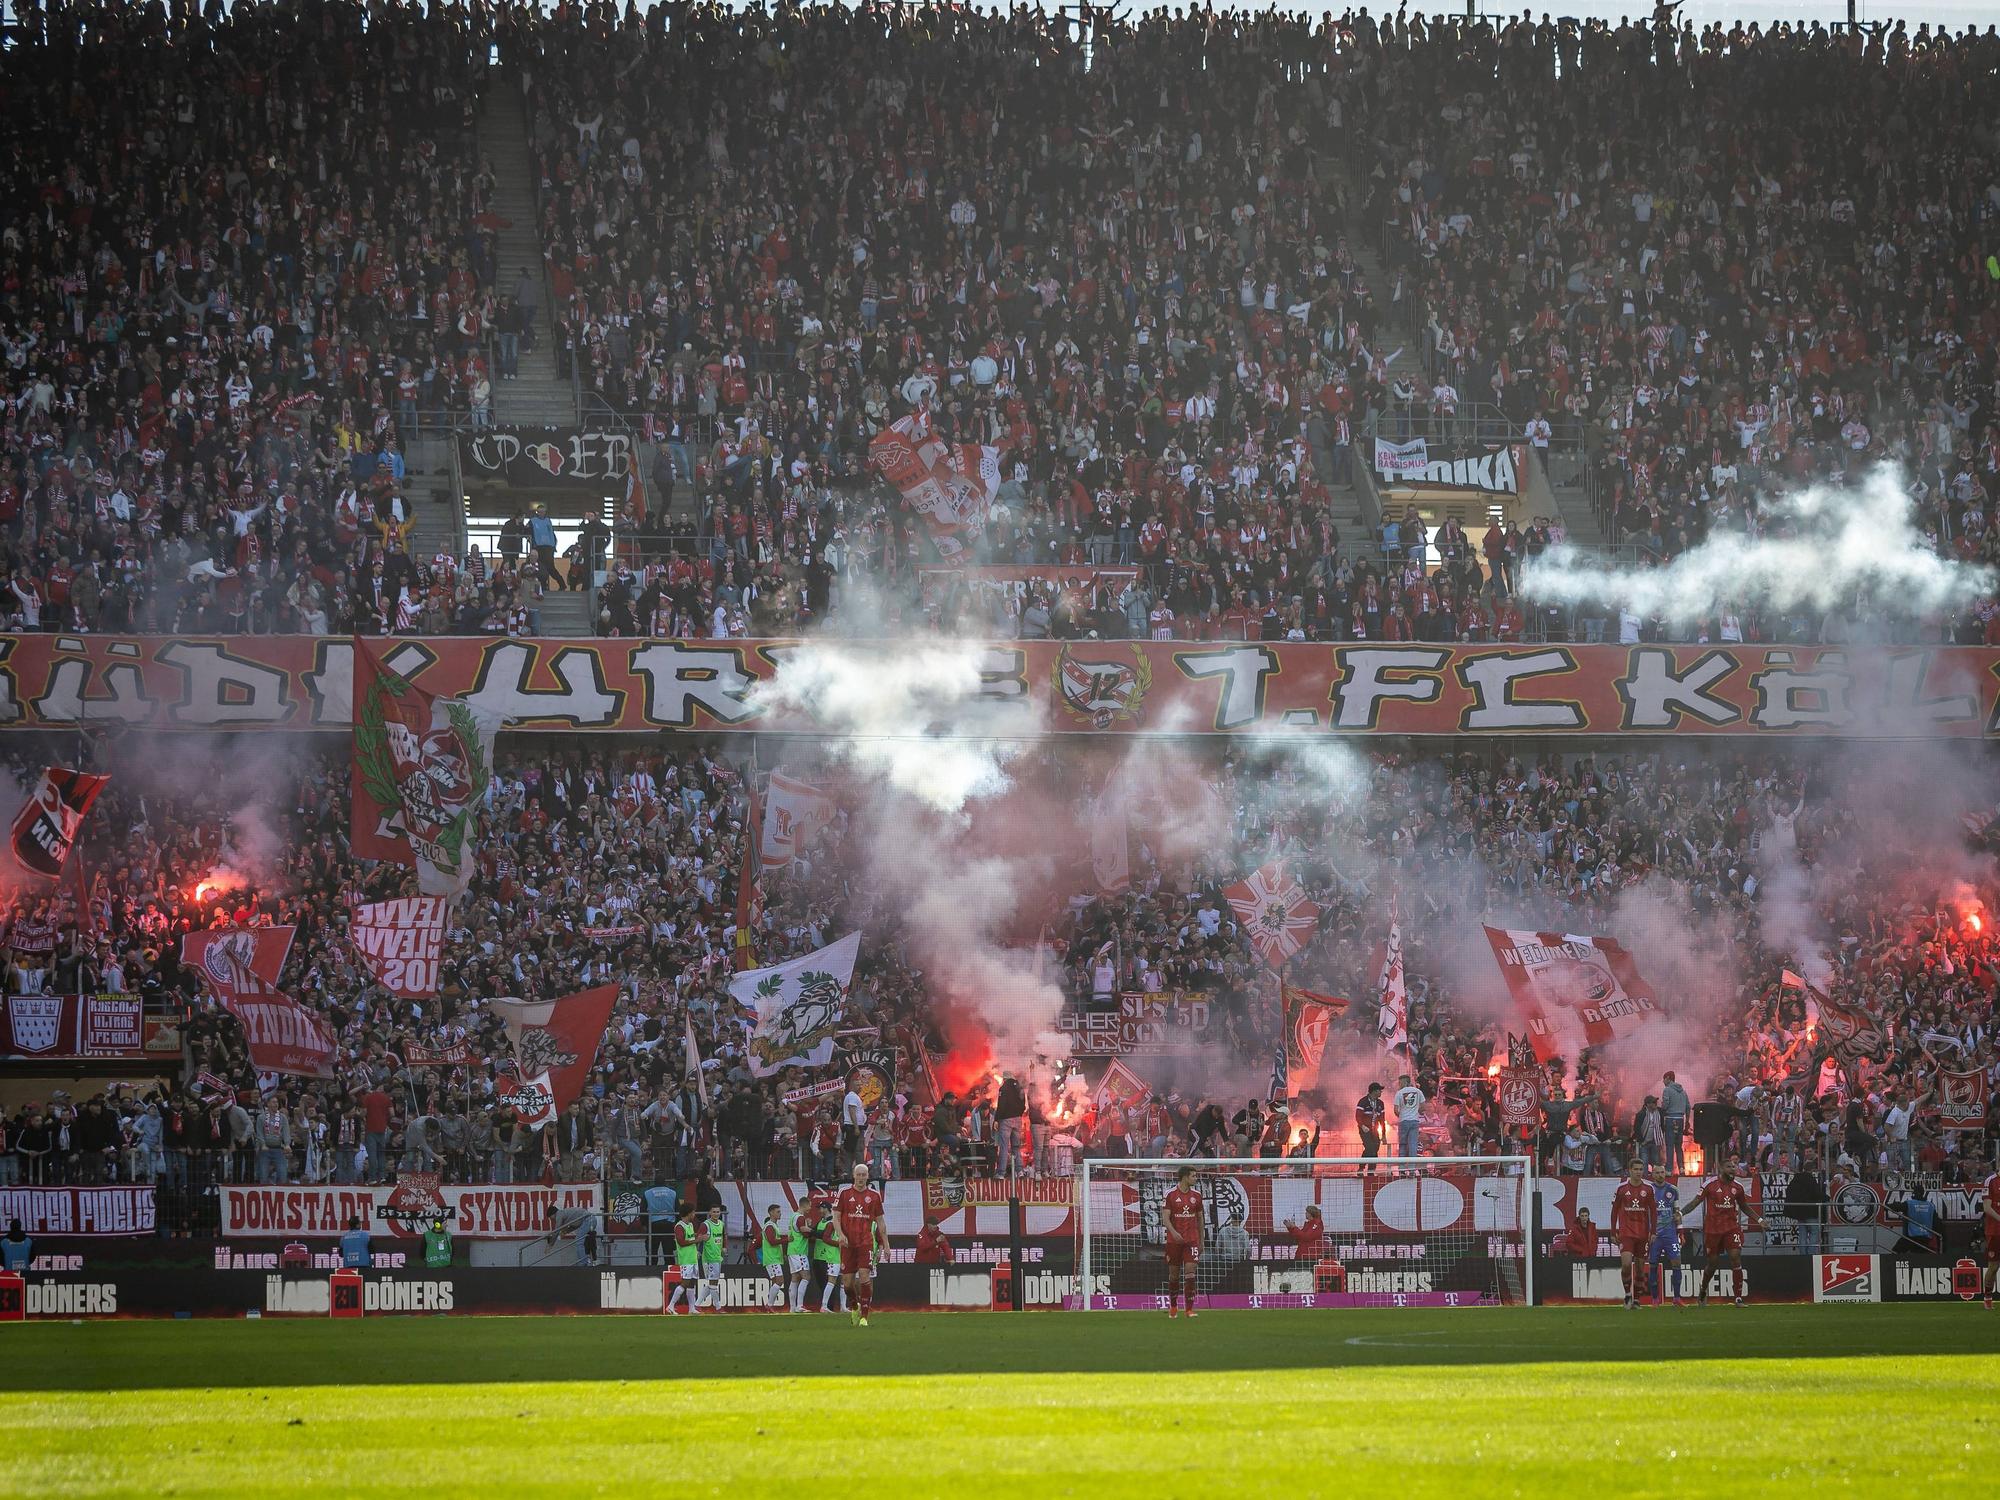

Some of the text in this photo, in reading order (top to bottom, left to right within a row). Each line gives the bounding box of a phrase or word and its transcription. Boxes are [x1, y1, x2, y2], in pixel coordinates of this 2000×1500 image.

[1377, 451, 1397, 461] KEIN
[1377, 459, 1427, 469] RASSISMUS
[1614, 648, 2000, 732] KÖL
[91, 1000, 139, 1013] RASCALS
[94, 1015, 134, 1029] ULTRAS
[845, 1050, 889, 1068] JUNGE
[965, 1177, 1076, 1204] STADIONVERBOT
[1925, 1180, 1941, 1189] NOI
[0, 1190, 156, 1232] EMPER FIDELIS
[229, 1191, 374, 1231] DOMSTADT
[416, 1207, 452, 1218] 2007
[1190, 1246, 1199, 1256] 15
[601, 1272, 616, 1280] DAS
[930, 1269, 945, 1277] DAS
[1253, 1266, 1433, 1294] HA DÖNERS
[1572, 1269, 1626, 1299] HA
[1896, 1267, 1951, 1295] HAUS
[266, 1281, 330, 1312] HA
[364, 1276, 454, 1311] DÖNERS
[601, 1279, 662, 1309] HA
[929, 1276, 992, 1306] HA
[1856, 1276, 1869, 1293] 2
[26, 1278, 117, 1314] DÖNERS
